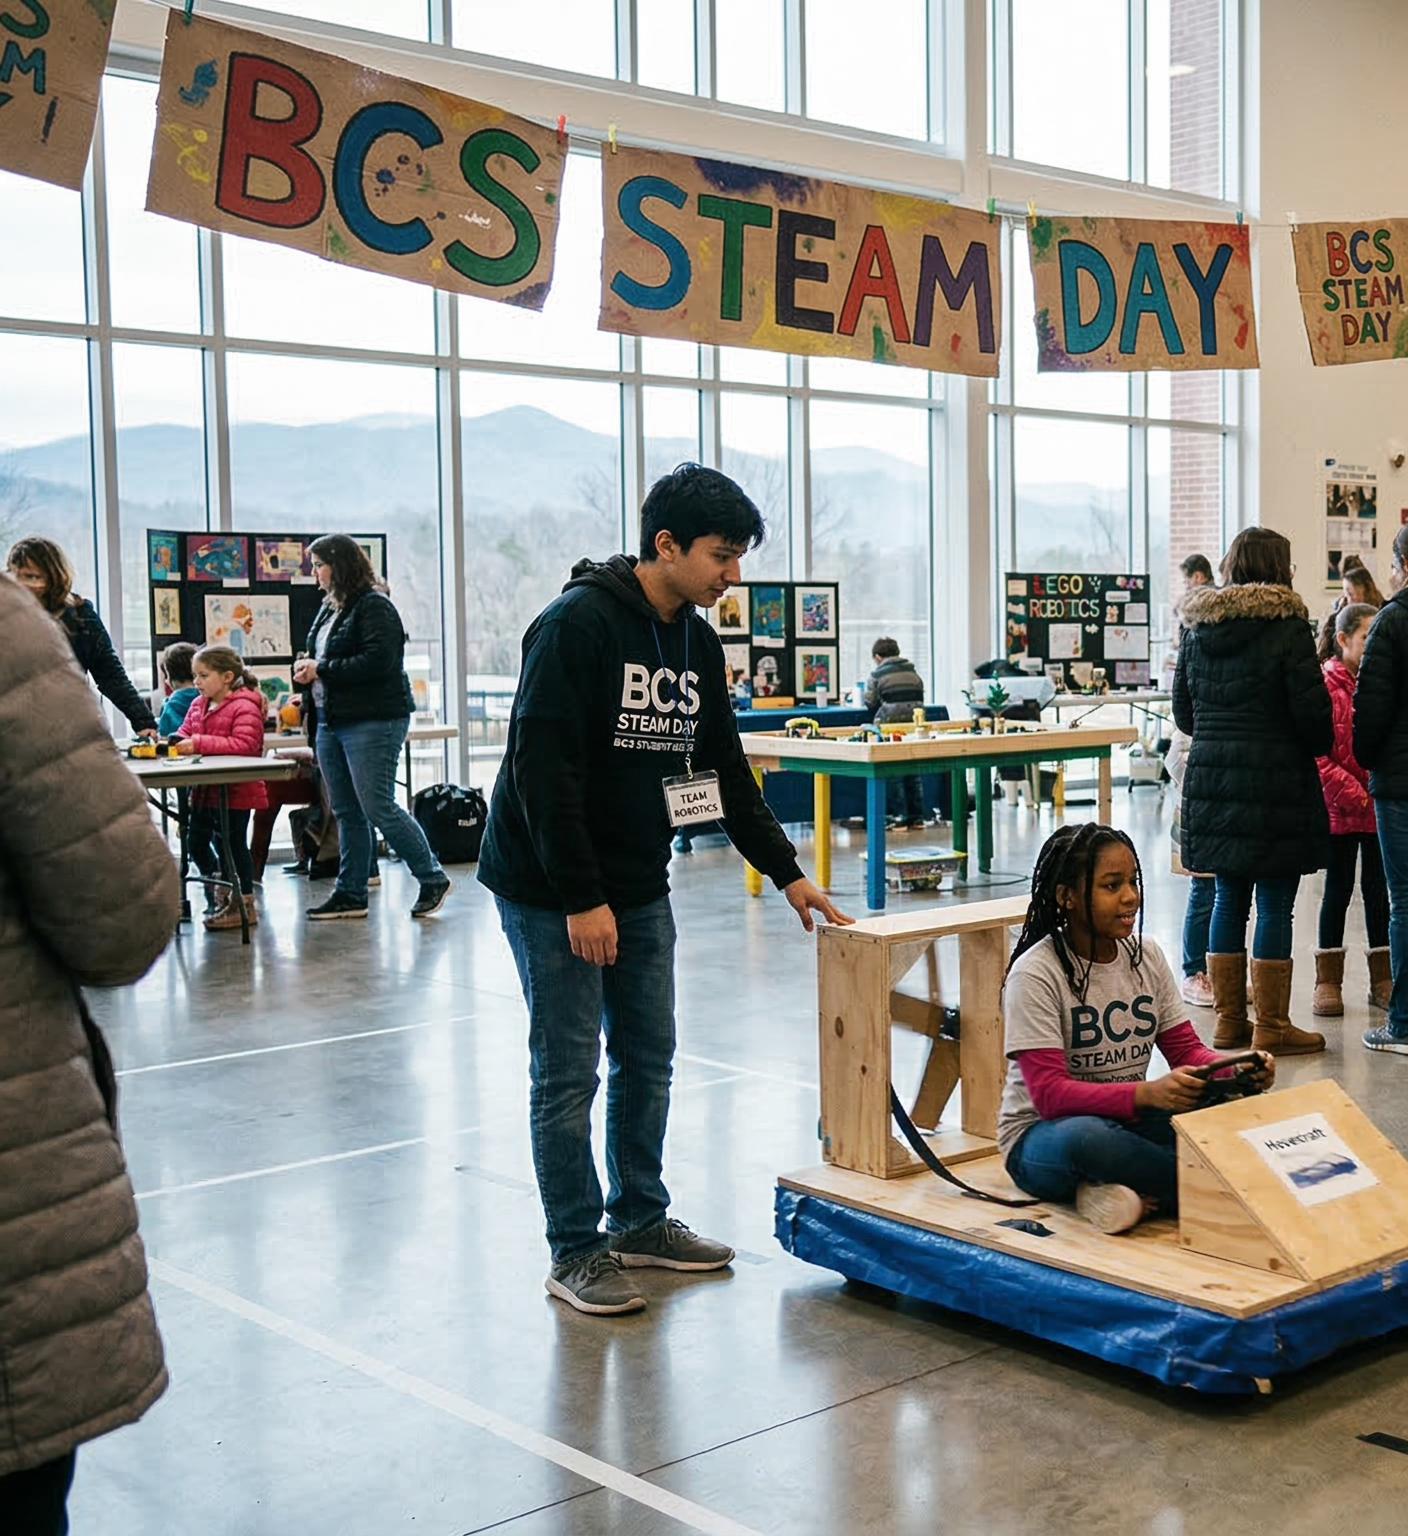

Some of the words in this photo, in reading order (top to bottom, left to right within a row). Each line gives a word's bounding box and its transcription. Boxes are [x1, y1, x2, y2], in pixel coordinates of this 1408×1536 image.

[215, 51, 542, 287] BCS
[610, 175, 996, 354] STEAM
[1058, 239, 1234, 356] DAY
[1326, 229, 1394, 277] BCS
[1322, 275, 1404, 311] STEAM
[1341, 311, 1391, 346] DAY
[1033, 575, 1083, 595] LEGO
[1029, 599, 1100, 618] ROBOTICS
[621, 663, 700, 715] BCS
[617, 713, 670, 734] STEAM
[673, 719, 698, 735] DAY
[674, 804, 718, 818] ROBOTICS
[680, 791, 708, 804] TEAM
[1071, 995, 1157, 1049] BCS
[1071, 1047, 1126, 1069] STEAM
